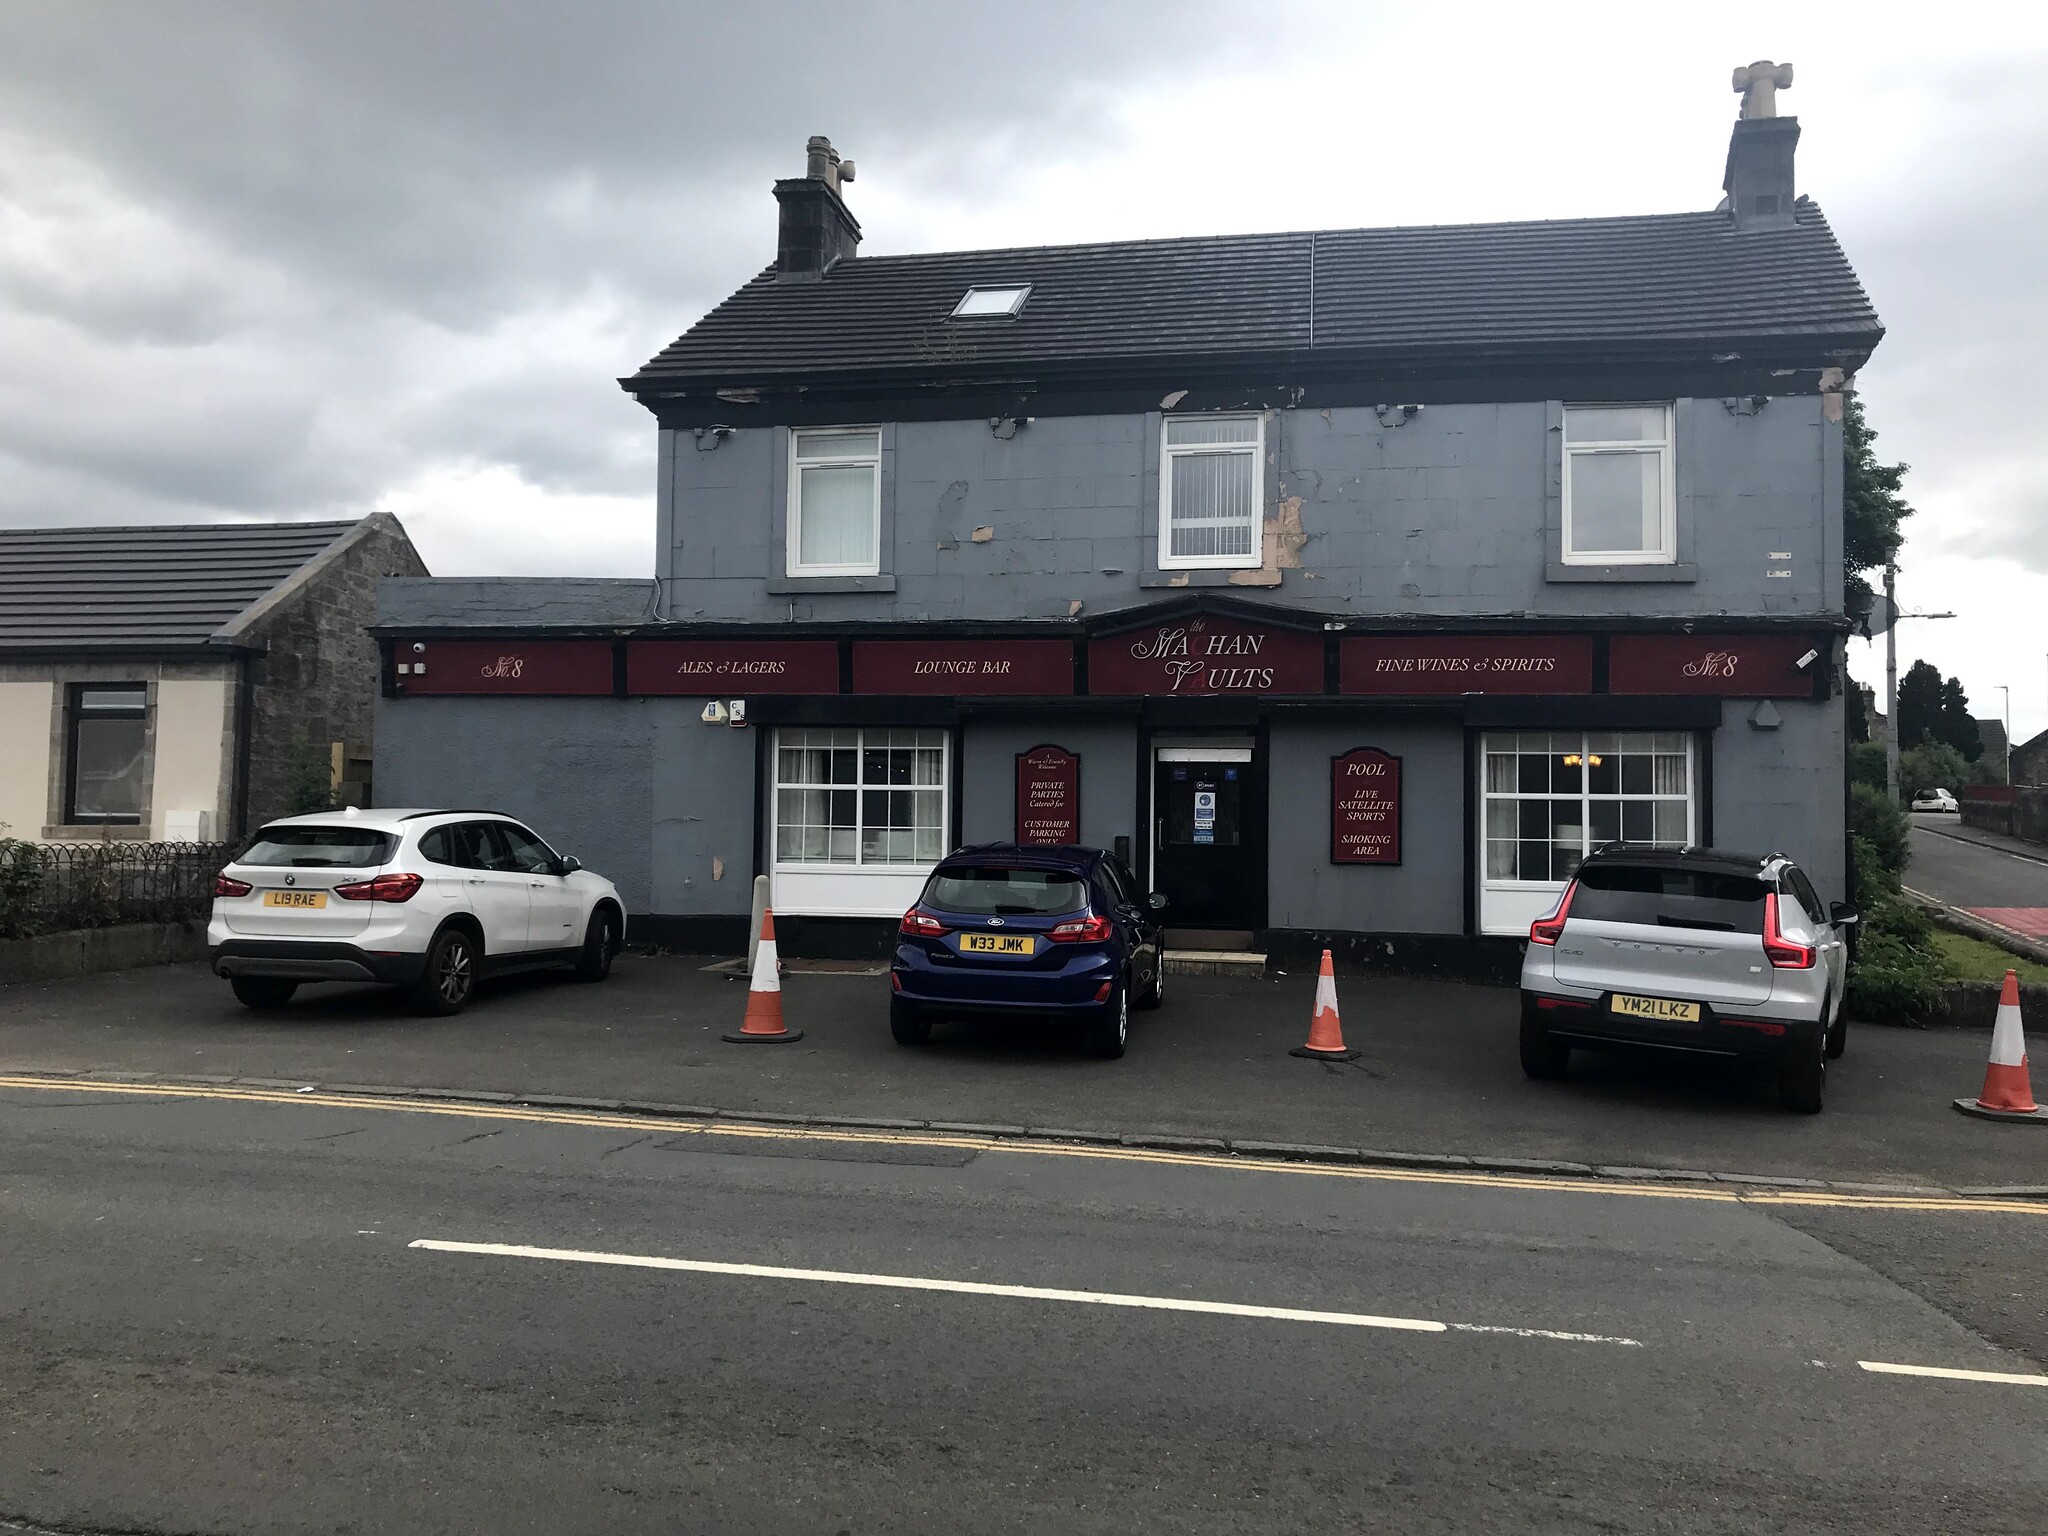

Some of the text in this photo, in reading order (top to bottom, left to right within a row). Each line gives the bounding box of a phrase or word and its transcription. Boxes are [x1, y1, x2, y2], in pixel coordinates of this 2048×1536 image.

[1190, 616, 1205, 632] the
[1131, 628, 1265, 659] MACHAN
[678, 661, 786, 674] ALES & LAGERS
[914, 661, 1010, 674] LOUNGE BAR
[1375, 657, 1556, 672] FINE WINES & SPIRITS
[1164, 660, 1274, 691] VAULTS
[1346, 764, 1386, 776] POOL
[1354, 790, 1379, 798] LIVE
[1030, 800, 1065, 809] Catered for
[1338, 801, 1394, 810] SATELLITE
[1346, 812, 1386, 820] SPORTS
[1024, 820, 1070, 828] CUSTOMER
[1342, 834, 1390, 844] SMOKING
[1353, 846, 1380, 854] AREA
[274, 892, 316, 906] L19 RAE
[970, 936, 1024, 952] W33 JMK
[1611, 940, 1706, 955] VOLVO
[1622, 997, 1690, 1018] YM21 LKZ
